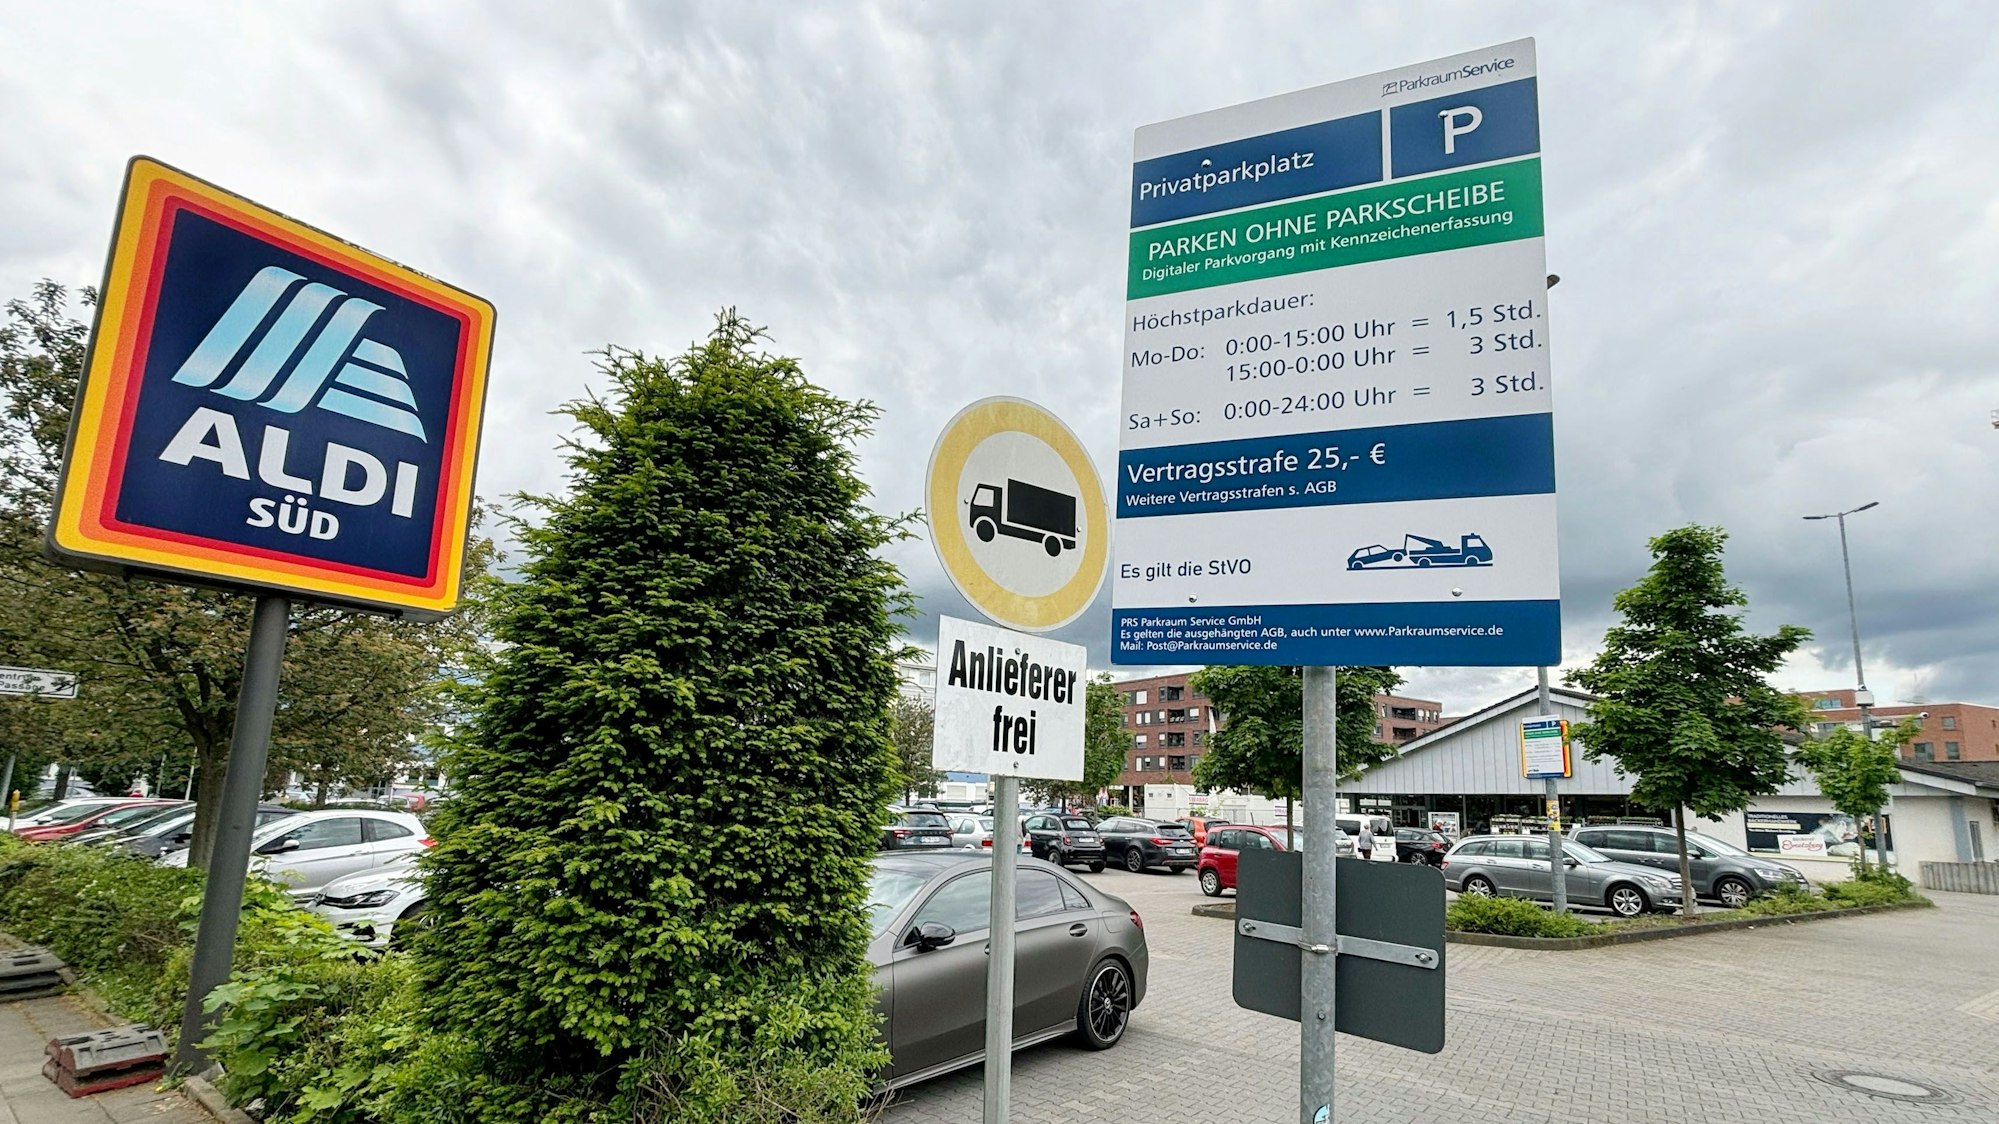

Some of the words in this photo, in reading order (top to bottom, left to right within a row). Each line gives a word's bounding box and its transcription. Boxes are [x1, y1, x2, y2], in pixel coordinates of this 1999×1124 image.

[1400, 58, 1515, 92] ParkraumService
[1443, 106, 1482, 154] P
[1140, 150, 1314, 200] Privatparkplatz
[1142, 261, 1200, 280] Digitaler
[1204, 247, 1295, 272] Parkvorgang
[1300, 240, 1326, 254] mit
[1330, 209, 1513, 249] Kennzeichenerfassung
[1149, 228, 1236, 260] PARKEN
[1245, 214, 1316, 243] OHNE
[1327, 181, 1505, 229] PARKSCHEIBE
[1131, 344, 1206, 368] Mo-Do:
[1225, 327, 1345, 357] 0:00-15:00
[1354, 319, 1396, 340] Uhr
[1446, 307, 1483, 331] 1,5
[1493, 300, 1542, 323] Std.
[1133, 292, 1314, 332] Höchstparkdauer:
[1227, 352, 1345, 382] 15:00-0:00
[1355, 346, 1396, 366] Uhr
[1469, 336, 1483, 355] 3
[1494, 330, 1543, 352] Std.
[1129, 408, 1201, 430] Sa+So:
[1224, 391, 1345, 421] 0:00-24:00
[1355, 387, 1396, 407] Uhr
[1471, 377, 1485, 396] 3
[1495, 372, 1544, 393] Std.
[158, 406, 419, 518] ALDI
[1127, 450, 1299, 485] Vertragsstrafe
[1307, 446, 1360, 473] 25,-
[1369, 442, 1386, 465] €
[246, 494, 340, 540] SÜD
[1126, 491, 1176, 507] Weitere
[1180, 485, 1284, 504] Vertragsstrafen
[1288, 487, 1300, 496] s.
[1304, 480, 1337, 494] AGB
[1120, 564, 1141, 579] Es
[1146, 562, 1172, 582] gilt
[1177, 561, 1203, 576] die
[1208, 559, 1251, 575] StVO
[1121, 618, 1138, 627] PRS
[1141, 616, 1187, 626] Parkraum
[1190, 616, 1225, 626] Service
[1228, 616, 1261, 626] GmbH
[1121, 629, 1130, 638] Es
[1133, 628, 1162, 640] gelten
[1166, 628, 1181, 638] die
[1184, 627, 1257, 640] ausgehängten
[1261, 627, 1288, 639] AGB,
[1291, 627, 1317, 637] auch
[1320, 628, 1350, 637] unter
[1355, 625, 1503, 637] www.Parkraumservice.de
[1120, 641, 1144, 651] Mail:
[1146, 640, 1277, 652] Post@Parkraumservice.de
[948, 639, 1076, 704] Anlieferer
[993, 705, 1036, 755] frei
